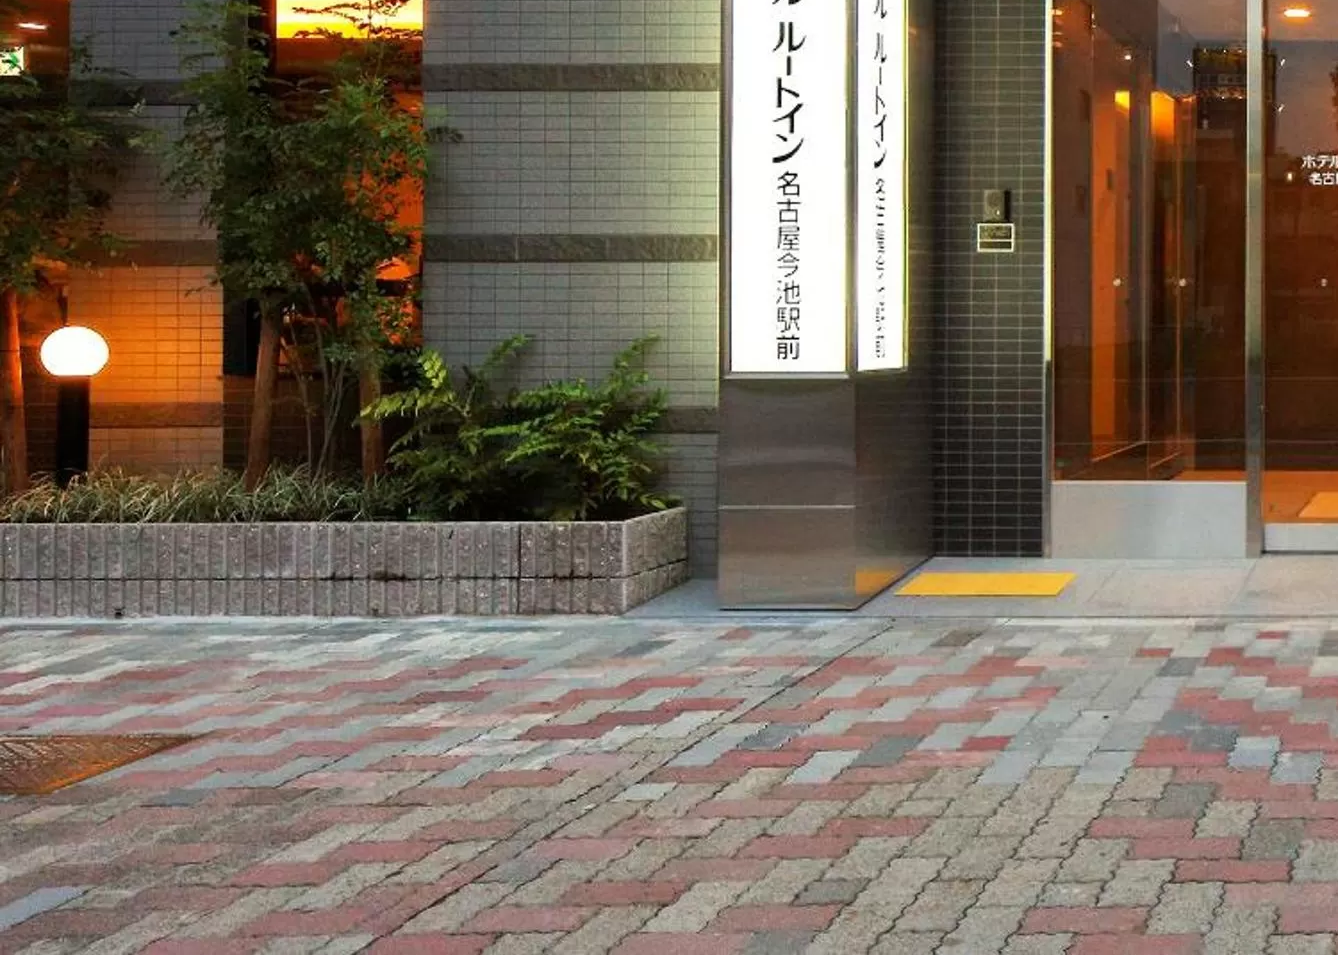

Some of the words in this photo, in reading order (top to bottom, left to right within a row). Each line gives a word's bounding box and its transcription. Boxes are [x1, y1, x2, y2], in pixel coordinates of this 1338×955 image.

[771, 21, 807, 164] ルートイン
[873, 32, 888, 169] ルートイン
[776, 170, 801, 360] 名古屋今池駅前
